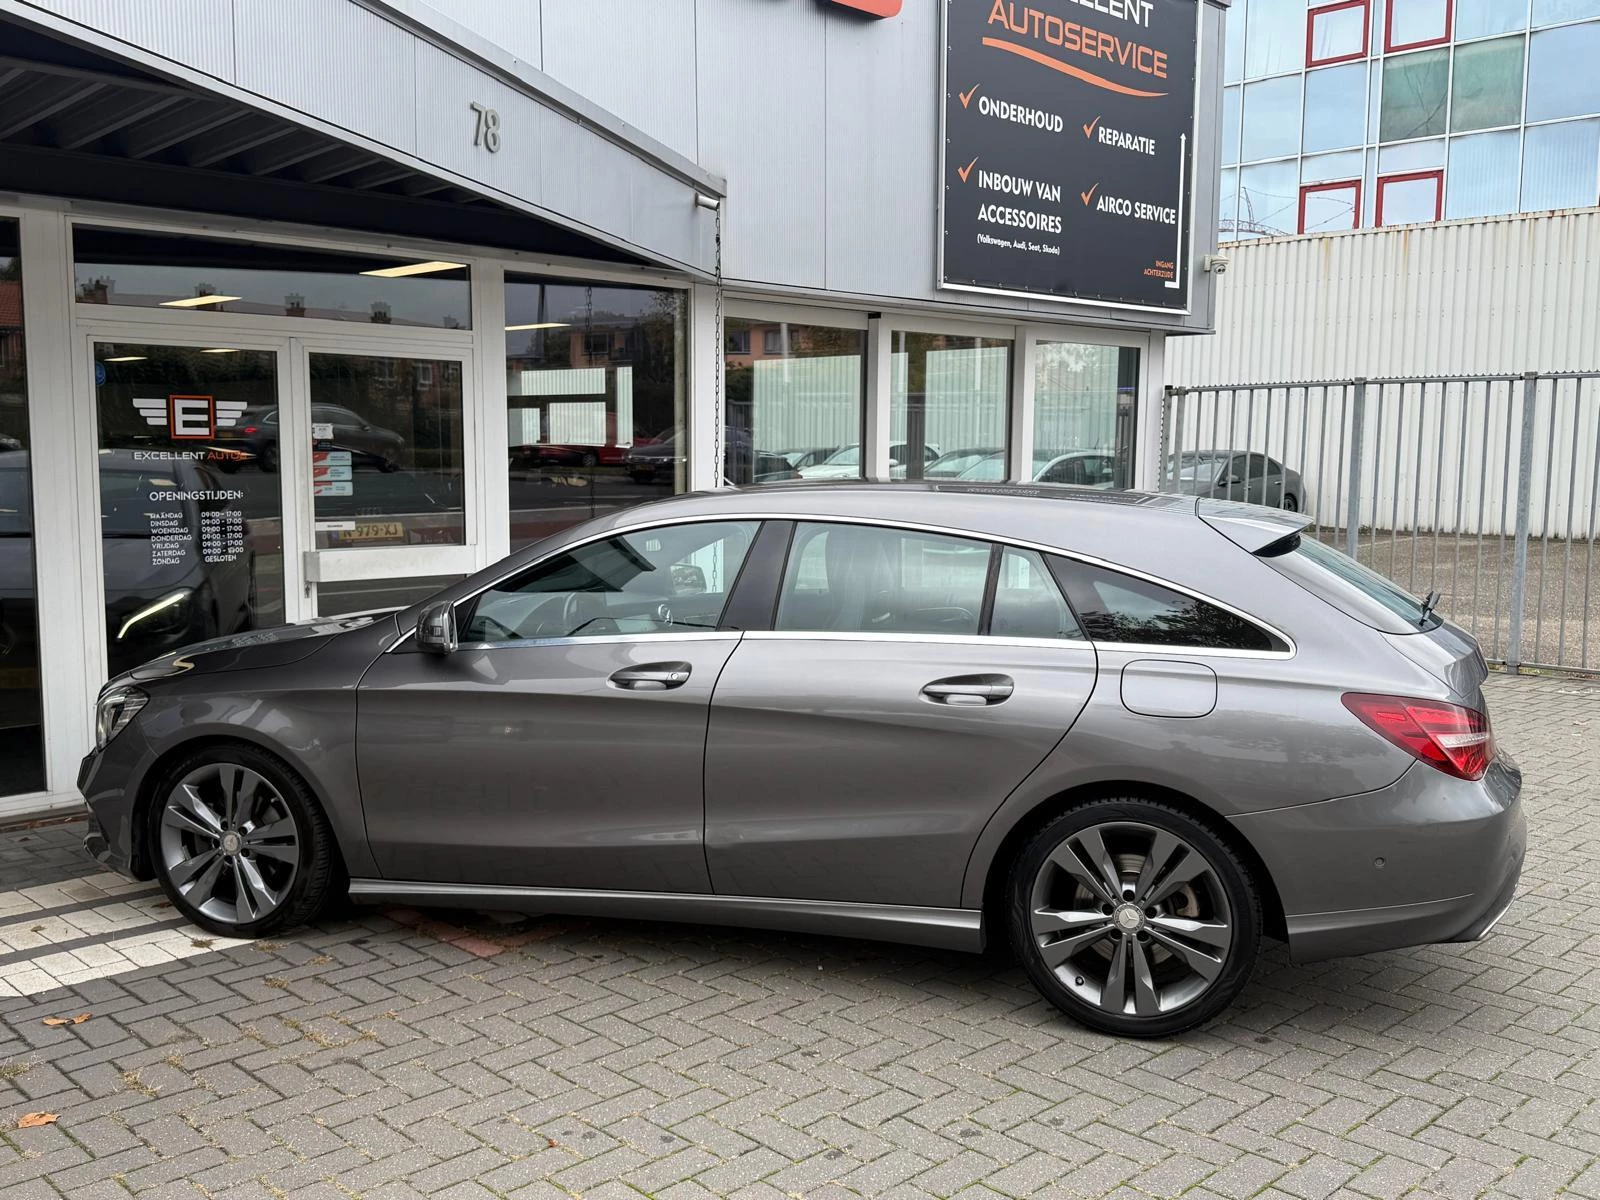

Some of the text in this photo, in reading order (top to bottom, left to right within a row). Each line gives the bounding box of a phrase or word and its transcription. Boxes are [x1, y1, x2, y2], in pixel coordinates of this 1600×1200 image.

[987, 0, 1168, 79] AUTOSERVICE
[470, 101, 501, 153] 78
[978, 96, 1064, 133] ONDERHOUD
[1098, 126, 1155, 155] REPARATIE
[978, 170, 1061, 203] INBOUW VAN
[977, 204, 1062, 234] ACCESSOIRES
[1096, 195, 1176, 225] AIRCO SERVICE
[977, 233, 1060, 256] (Volkswagen, Audi, Seat, Skoda)
[174, 399, 210, 435] E
[133, 451, 205, 460] EXCELLENT
[149, 490, 244, 501] OPENINGSTIJDEN:
[152, 554, 237, 566] ZONDAG GESLOTEN
